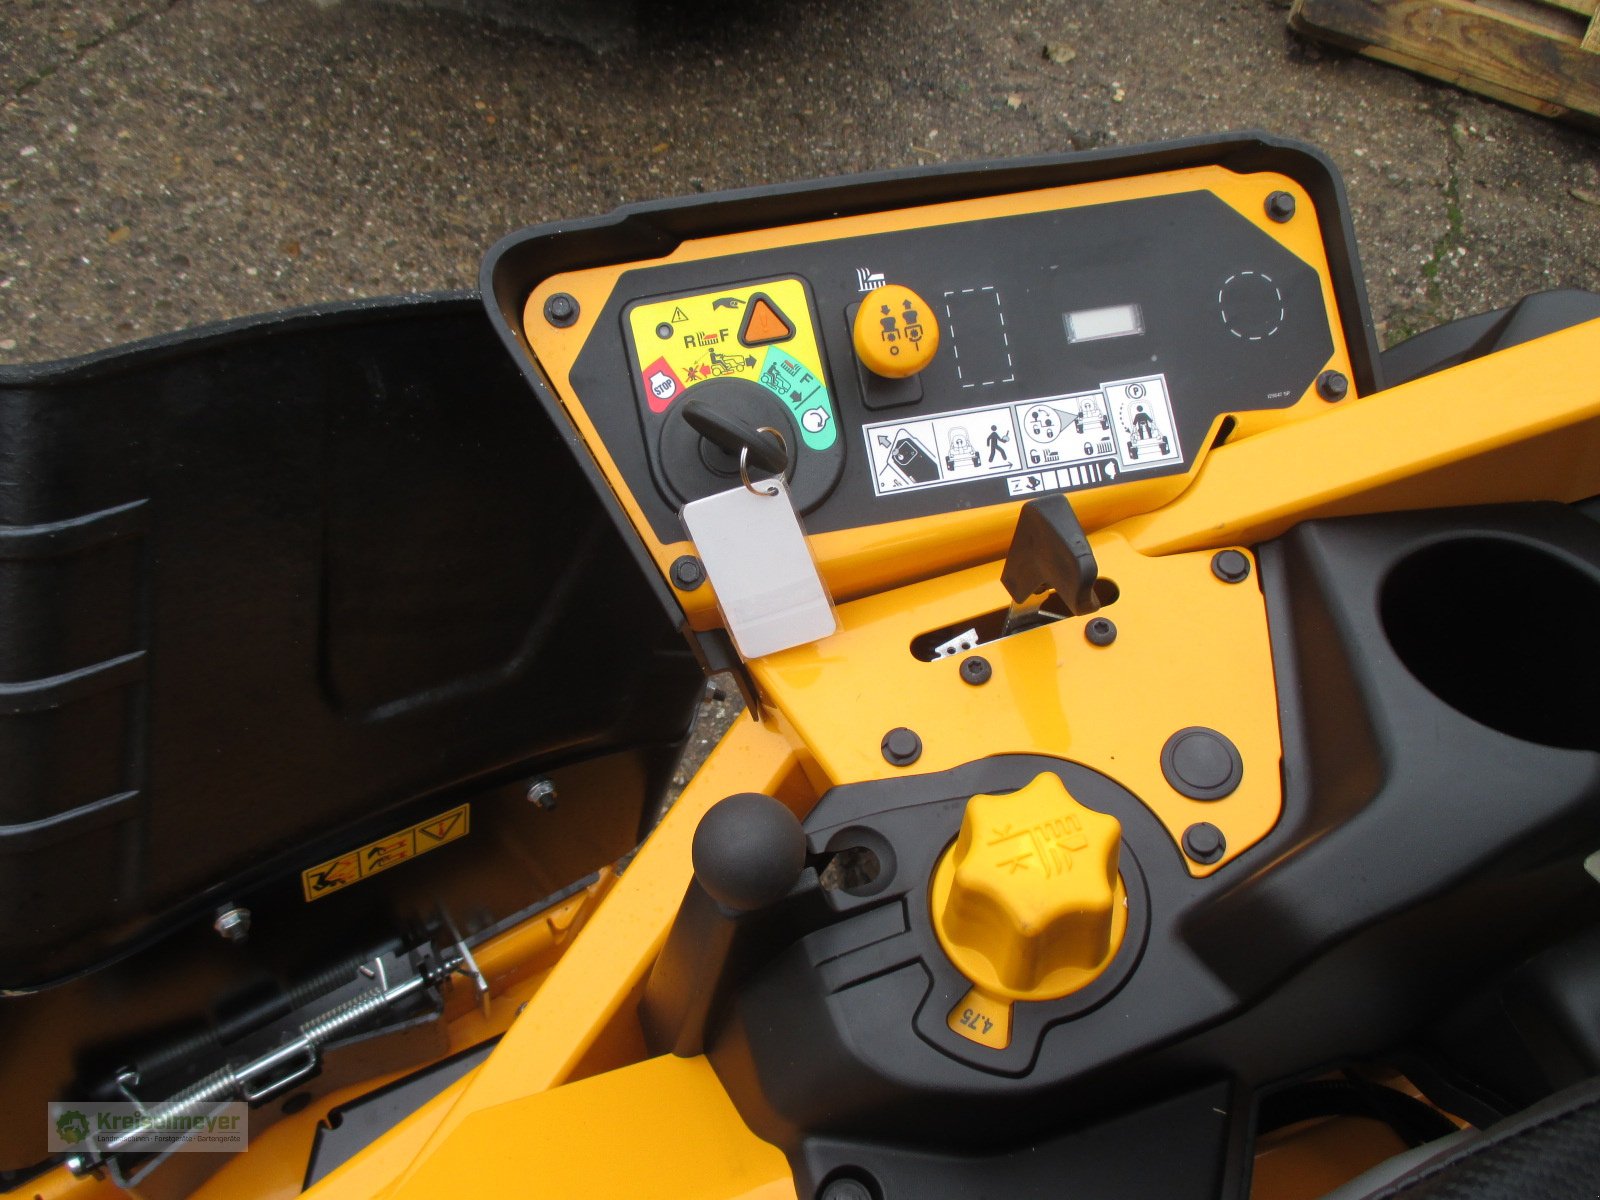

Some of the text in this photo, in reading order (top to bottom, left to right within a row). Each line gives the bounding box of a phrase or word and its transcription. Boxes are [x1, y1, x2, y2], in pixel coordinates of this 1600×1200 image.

[684, 328, 729, 349] R F
[653, 379, 673, 396] STOP
[800, 374, 814, 384] F
[960, 1009, 993, 1033] 4.75
